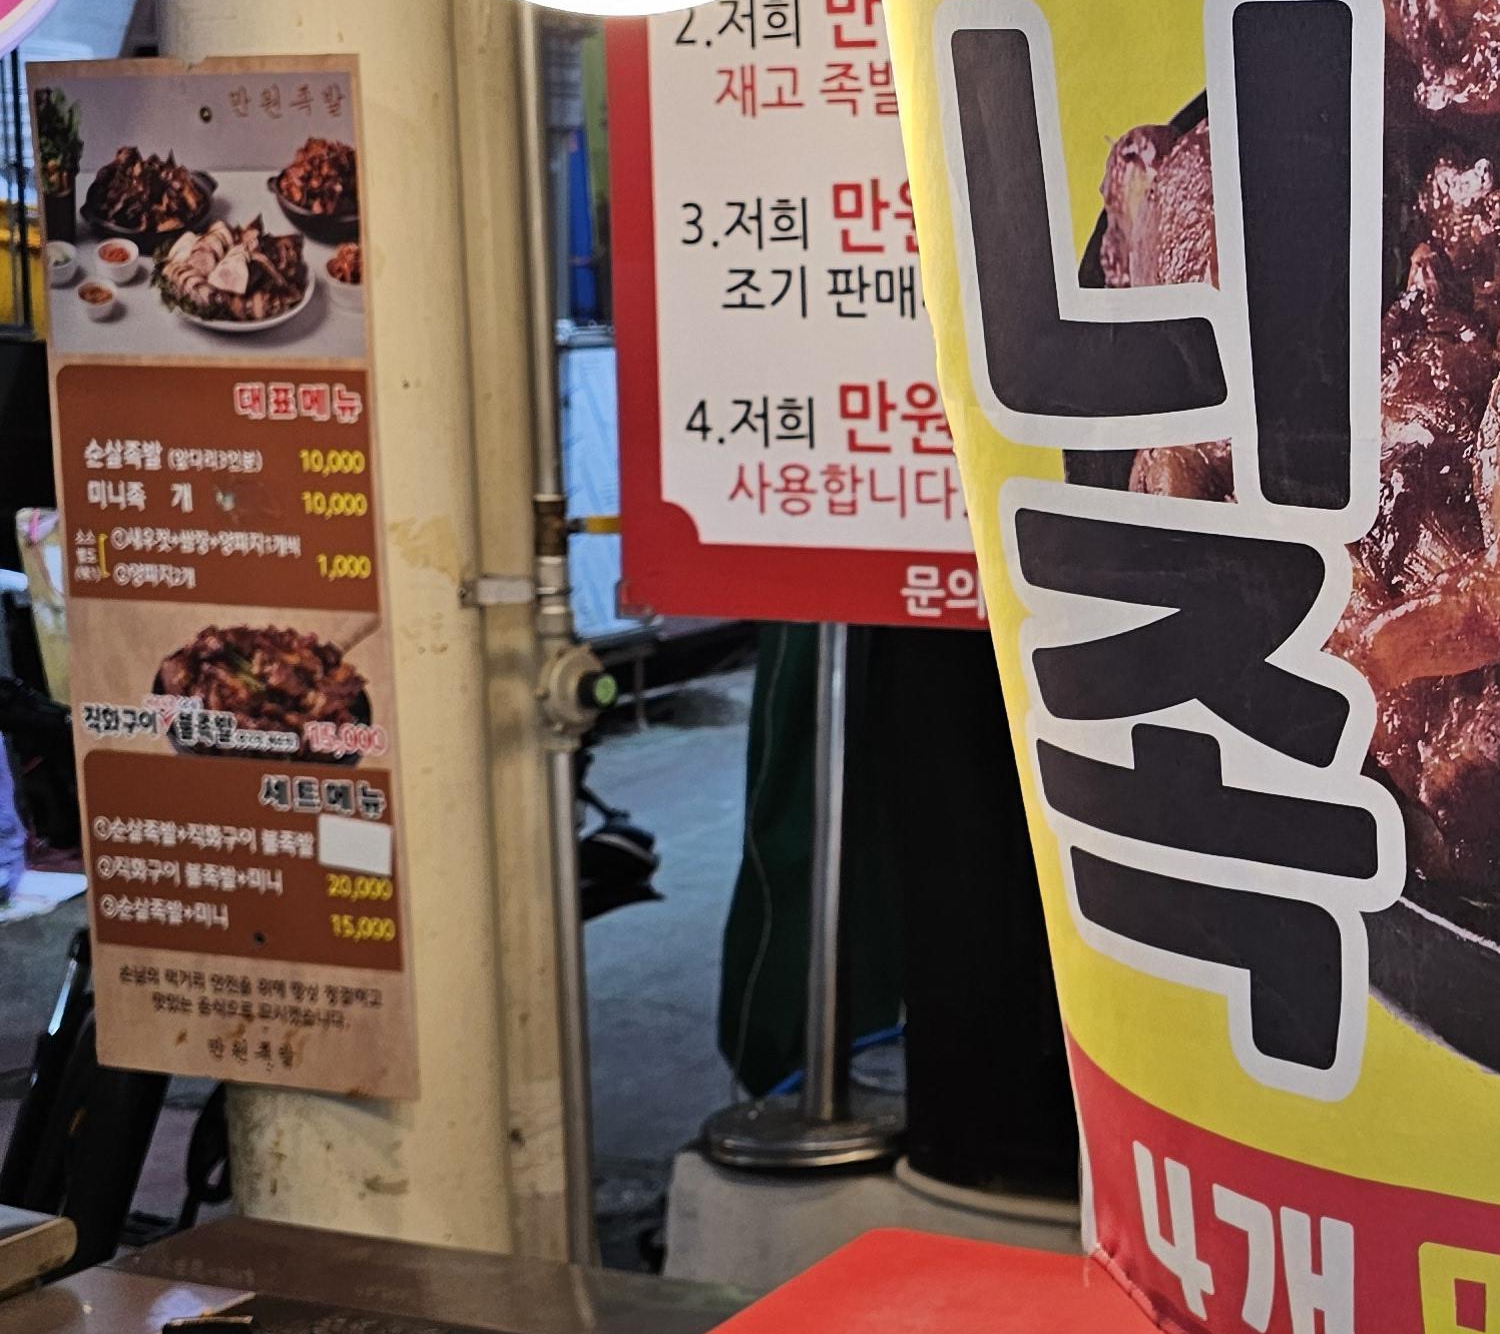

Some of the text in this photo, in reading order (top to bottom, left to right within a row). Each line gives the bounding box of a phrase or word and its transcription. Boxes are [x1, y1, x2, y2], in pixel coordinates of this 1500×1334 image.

[715, 63, 806, 119] 재고
[680, 196, 809, 252] 3.저희
[721, 264, 926, 320] 조기 판매
[233, 382, 363, 424] 대표메뉴
[685, 396, 816, 450] 4.저희
[84, 438, 163, 471] 순살족발
[299, 449, 365, 477] 10,000
[87, 479, 146, 512] 미니족
[302, 490, 367, 519] 10,000
[728, 461, 969, 521] 사용합니다.
[317, 553, 372, 583] 1,000
[83, 704, 159, 737] 직화구이
[259, 774, 387, 819] 세트메뉴
[326, 873, 393, 901] 20,000
[330, 913, 396, 942] 15,000
